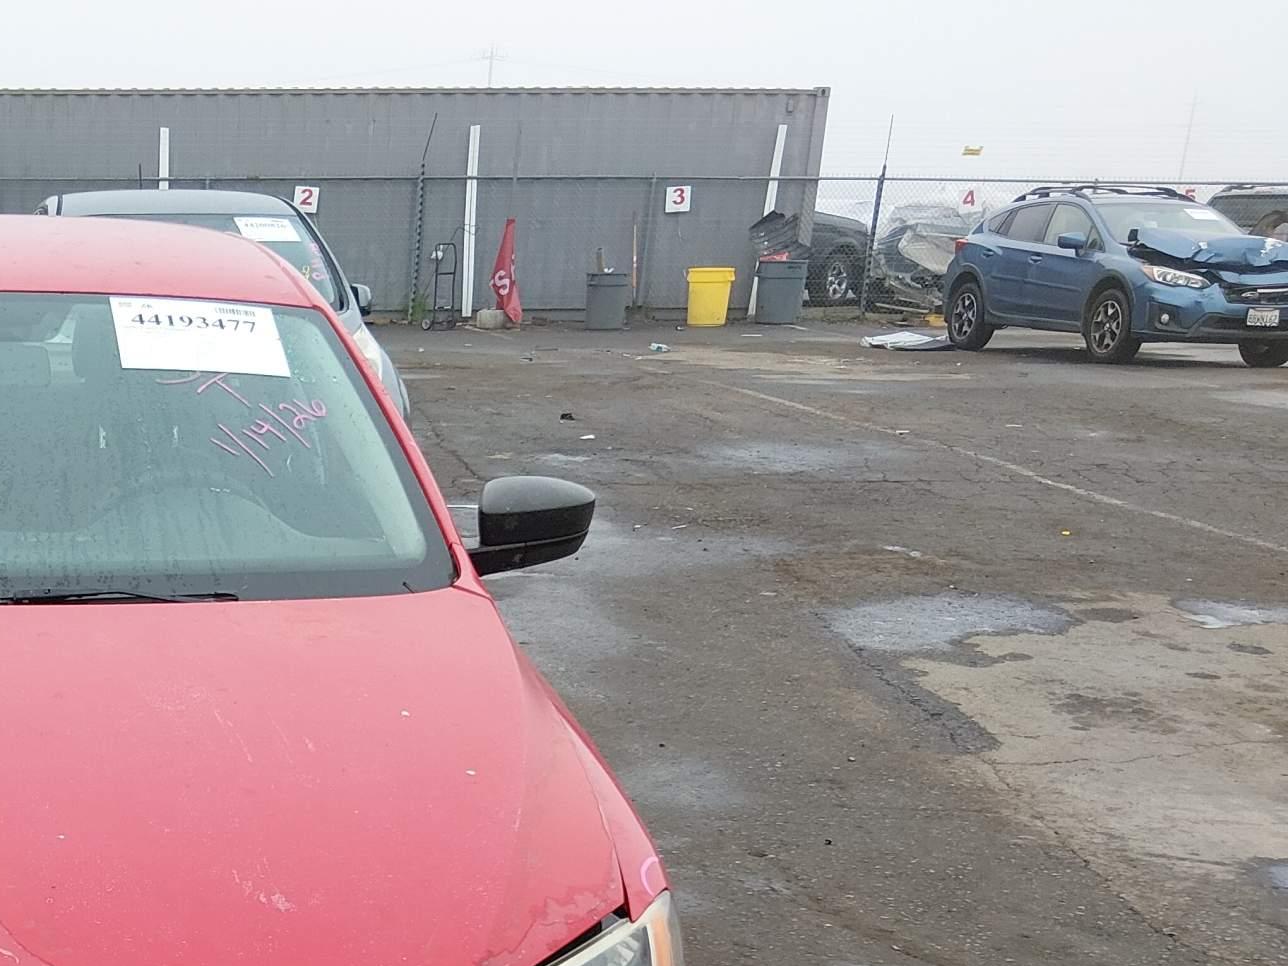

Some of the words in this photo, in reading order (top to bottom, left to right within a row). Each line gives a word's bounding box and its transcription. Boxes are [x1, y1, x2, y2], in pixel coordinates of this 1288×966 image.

[299, 188, 314, 206] 2
[671, 187, 685, 205] 3
[962, 189, 976, 206] 4
[131, 313, 256, 333] 44193477
[210, 399, 328, 478] 1/14/26
